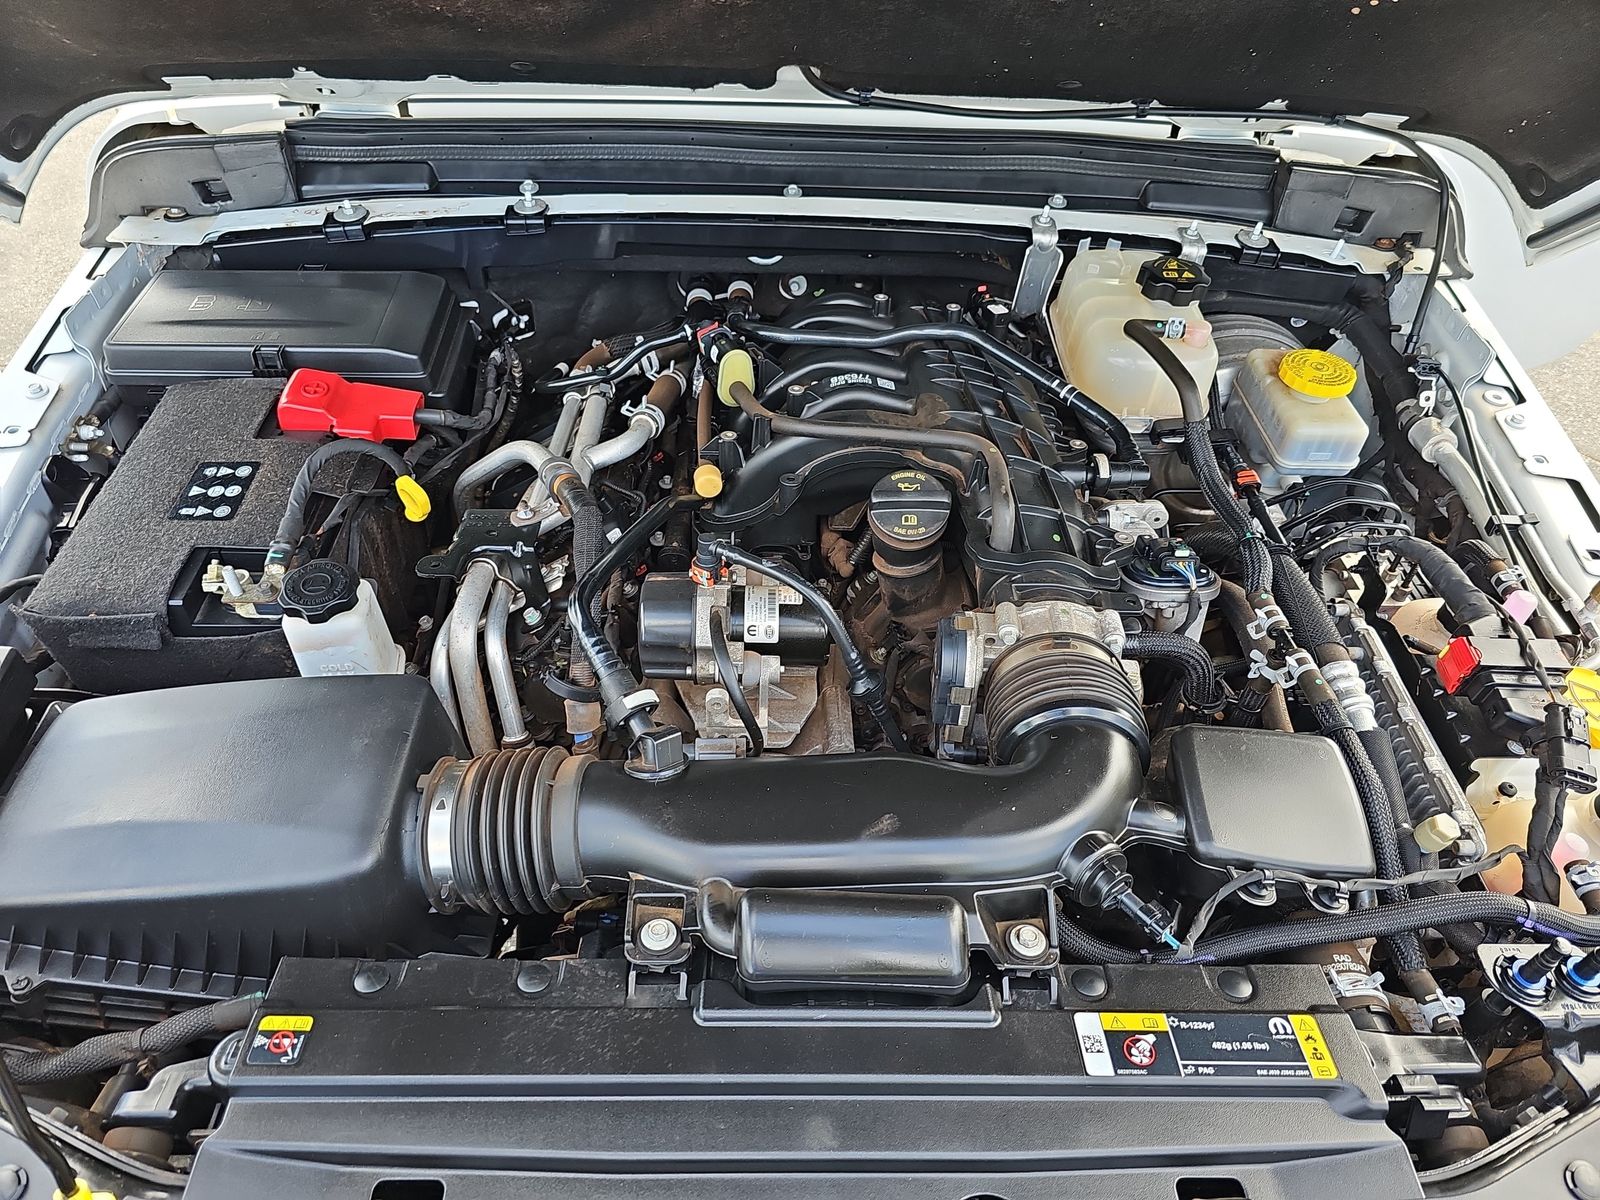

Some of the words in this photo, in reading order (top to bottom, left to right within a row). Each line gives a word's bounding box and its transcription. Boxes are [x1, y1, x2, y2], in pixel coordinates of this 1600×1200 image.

[891, 472, 915, 481] ENGINE
[915, 473, 926, 481] OIL
[320, 663, 355, 672] COLD
[1332, 954, 1352, 962] RAD
[1197, 1066, 1215, 1075] PAG
